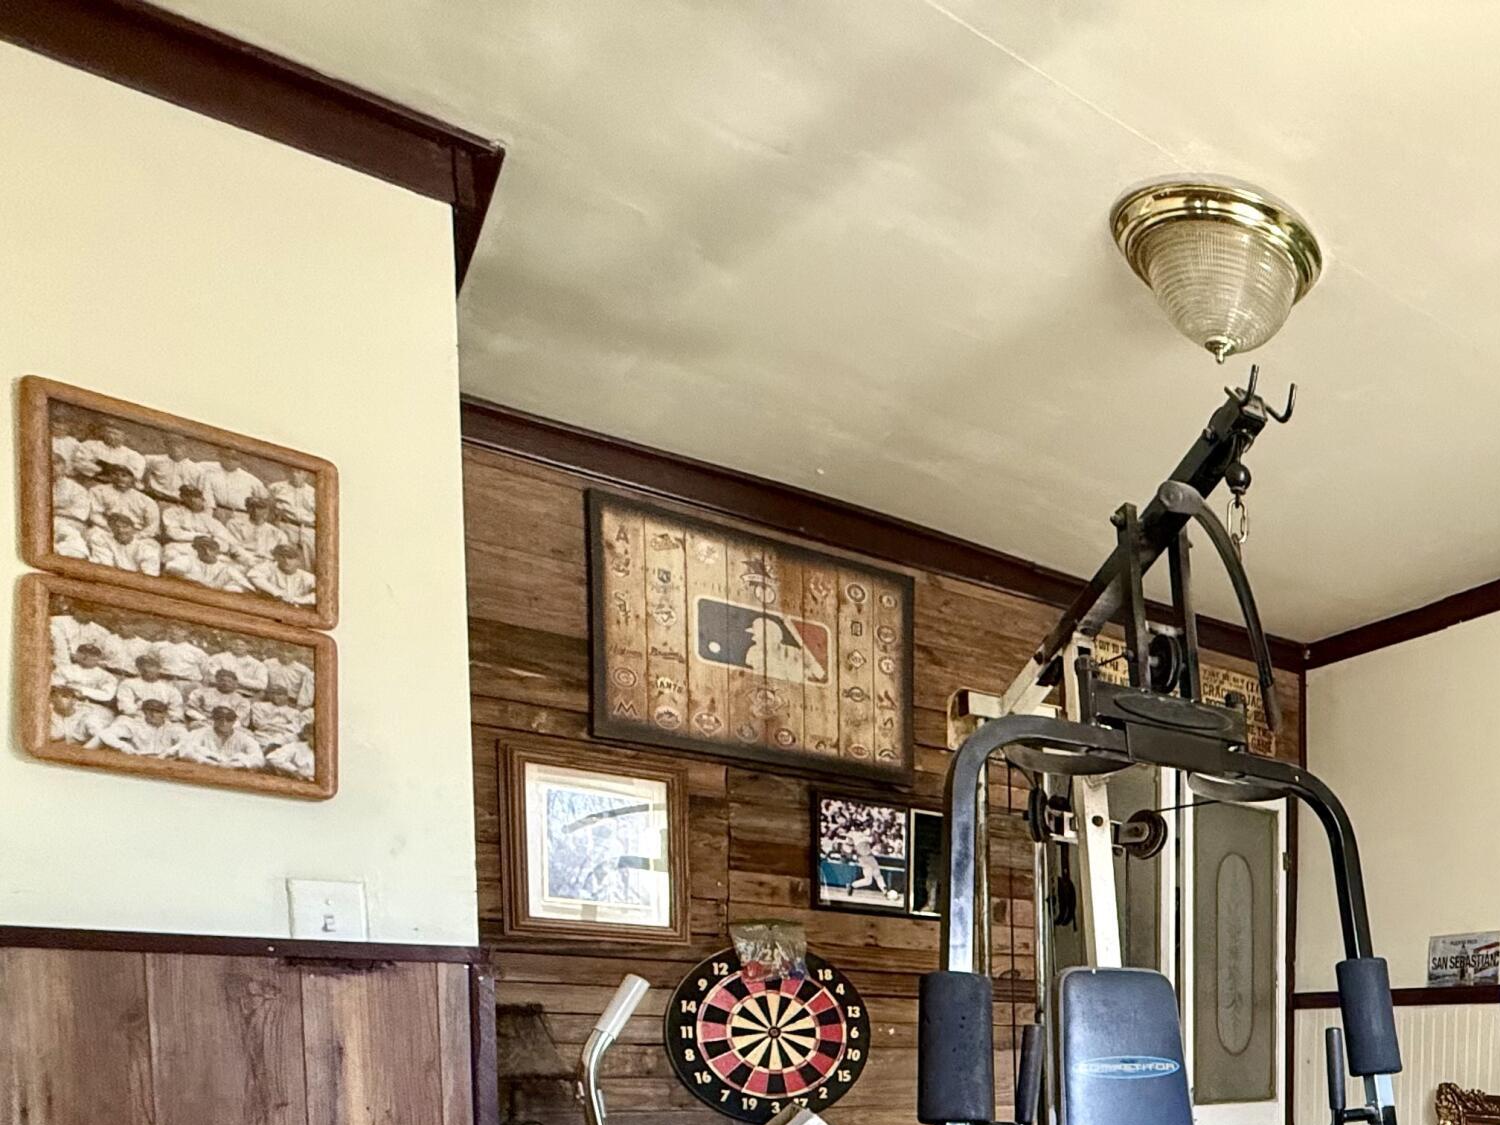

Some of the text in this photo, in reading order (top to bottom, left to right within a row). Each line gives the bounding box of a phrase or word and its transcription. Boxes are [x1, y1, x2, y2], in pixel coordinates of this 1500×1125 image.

[713, 962, 729, 976] 12
[1431, 956, 1448, 971] SAN
[817, 969, 833, 981] 18
[698, 979, 708, 991] 9
[836, 983, 845, 995] 4
[681, 1000, 697, 1013] 14
[847, 1006, 861, 1018] 13
[681, 1026, 694, 1039] 11
[850, 1026, 860, 1038] 6
[684, 1050, 695, 1062] 8
[847, 1049, 861, 1061] 10
[694, 1072, 712, 1084] 16
[838, 1070, 851, 1083] 15
[720, 1090, 730, 1102] 7
[819, 1087, 828, 1099] 2
[742, 1098, 758, 1110] 19
[771, 1102, 780, 1114] 3
